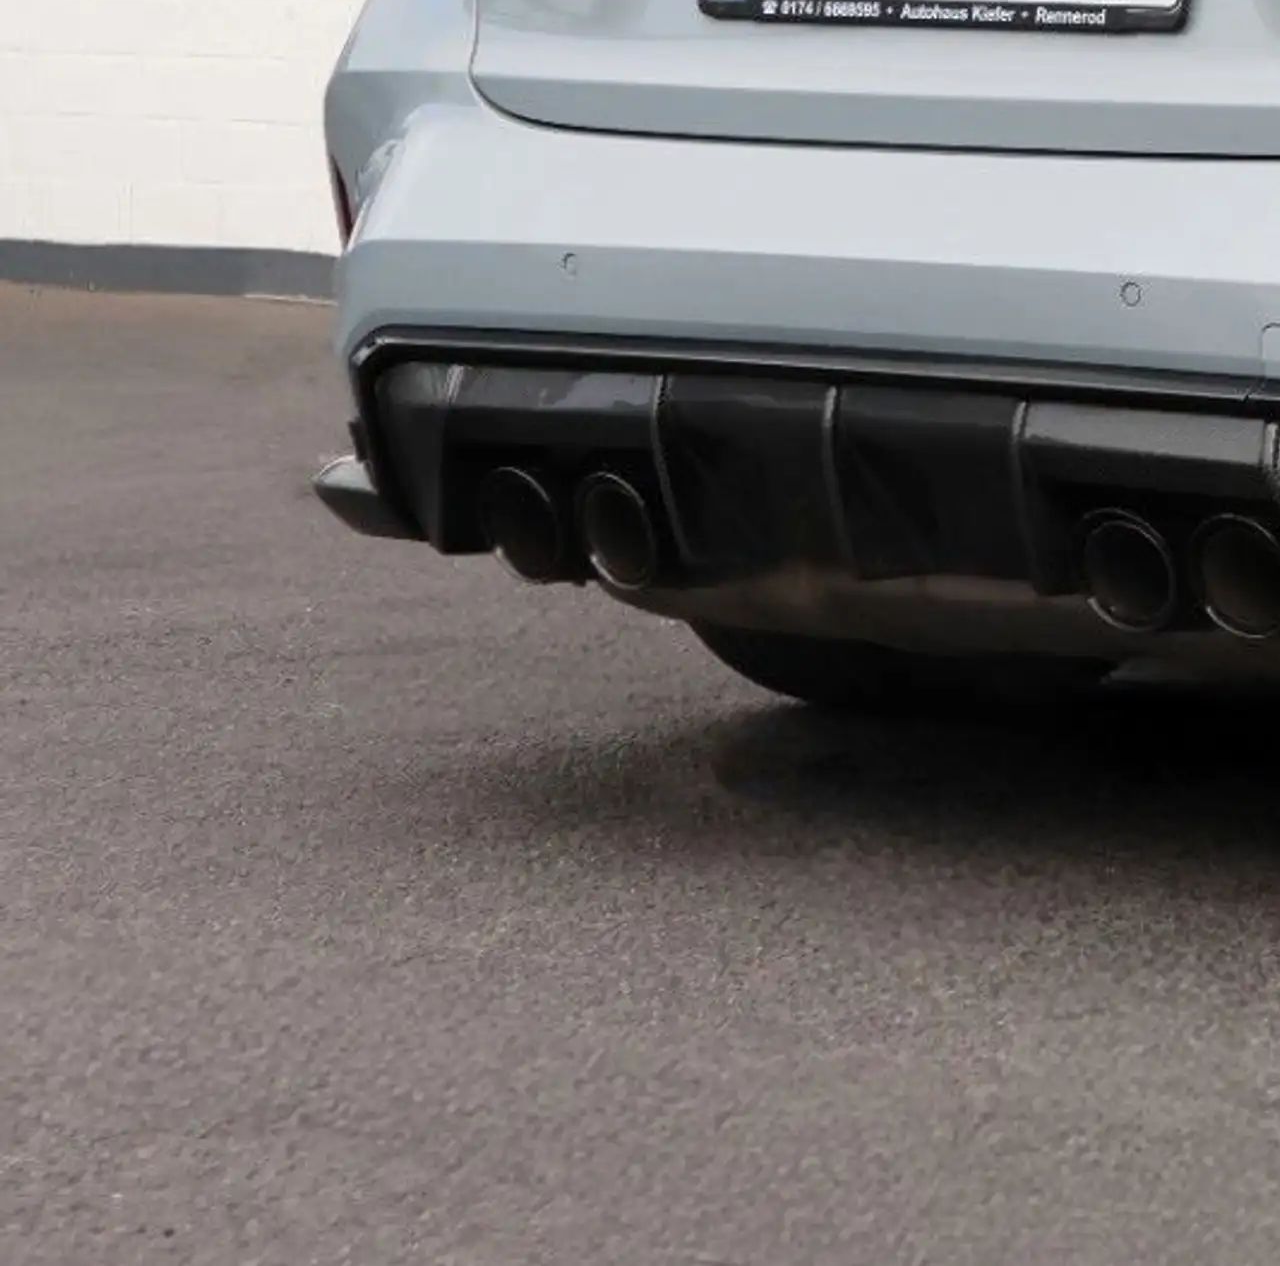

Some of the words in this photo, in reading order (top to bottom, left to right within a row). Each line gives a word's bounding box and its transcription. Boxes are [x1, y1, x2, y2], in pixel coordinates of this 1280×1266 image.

[900, 2, 969, 22] Autohaus
[971, 4, 1016, 23] Kiefer
[1035, 5, 1107, 26] Rennerod
